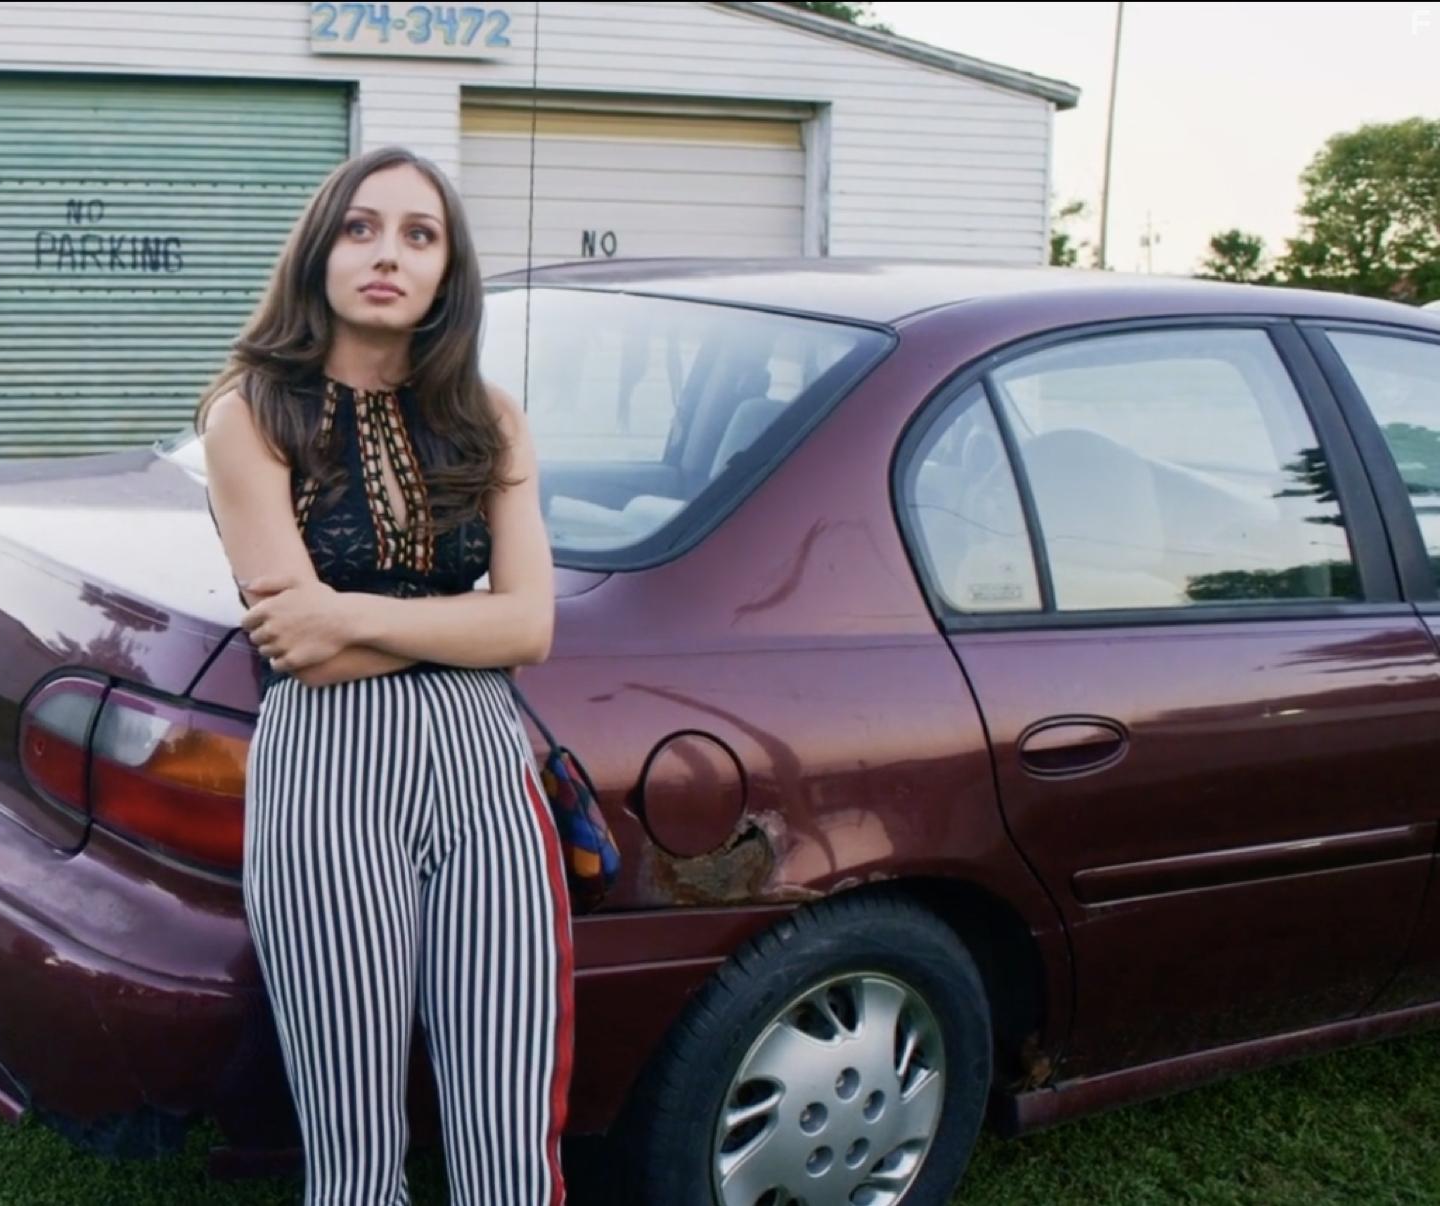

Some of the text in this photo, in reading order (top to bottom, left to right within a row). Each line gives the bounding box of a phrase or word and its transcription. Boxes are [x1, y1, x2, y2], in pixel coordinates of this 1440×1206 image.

[311, 3, 511, 47] 274-3472
[67, 199, 105, 224] NO
[35, 230, 184, 272] PARKING
[581, 230, 617, 258] NO
